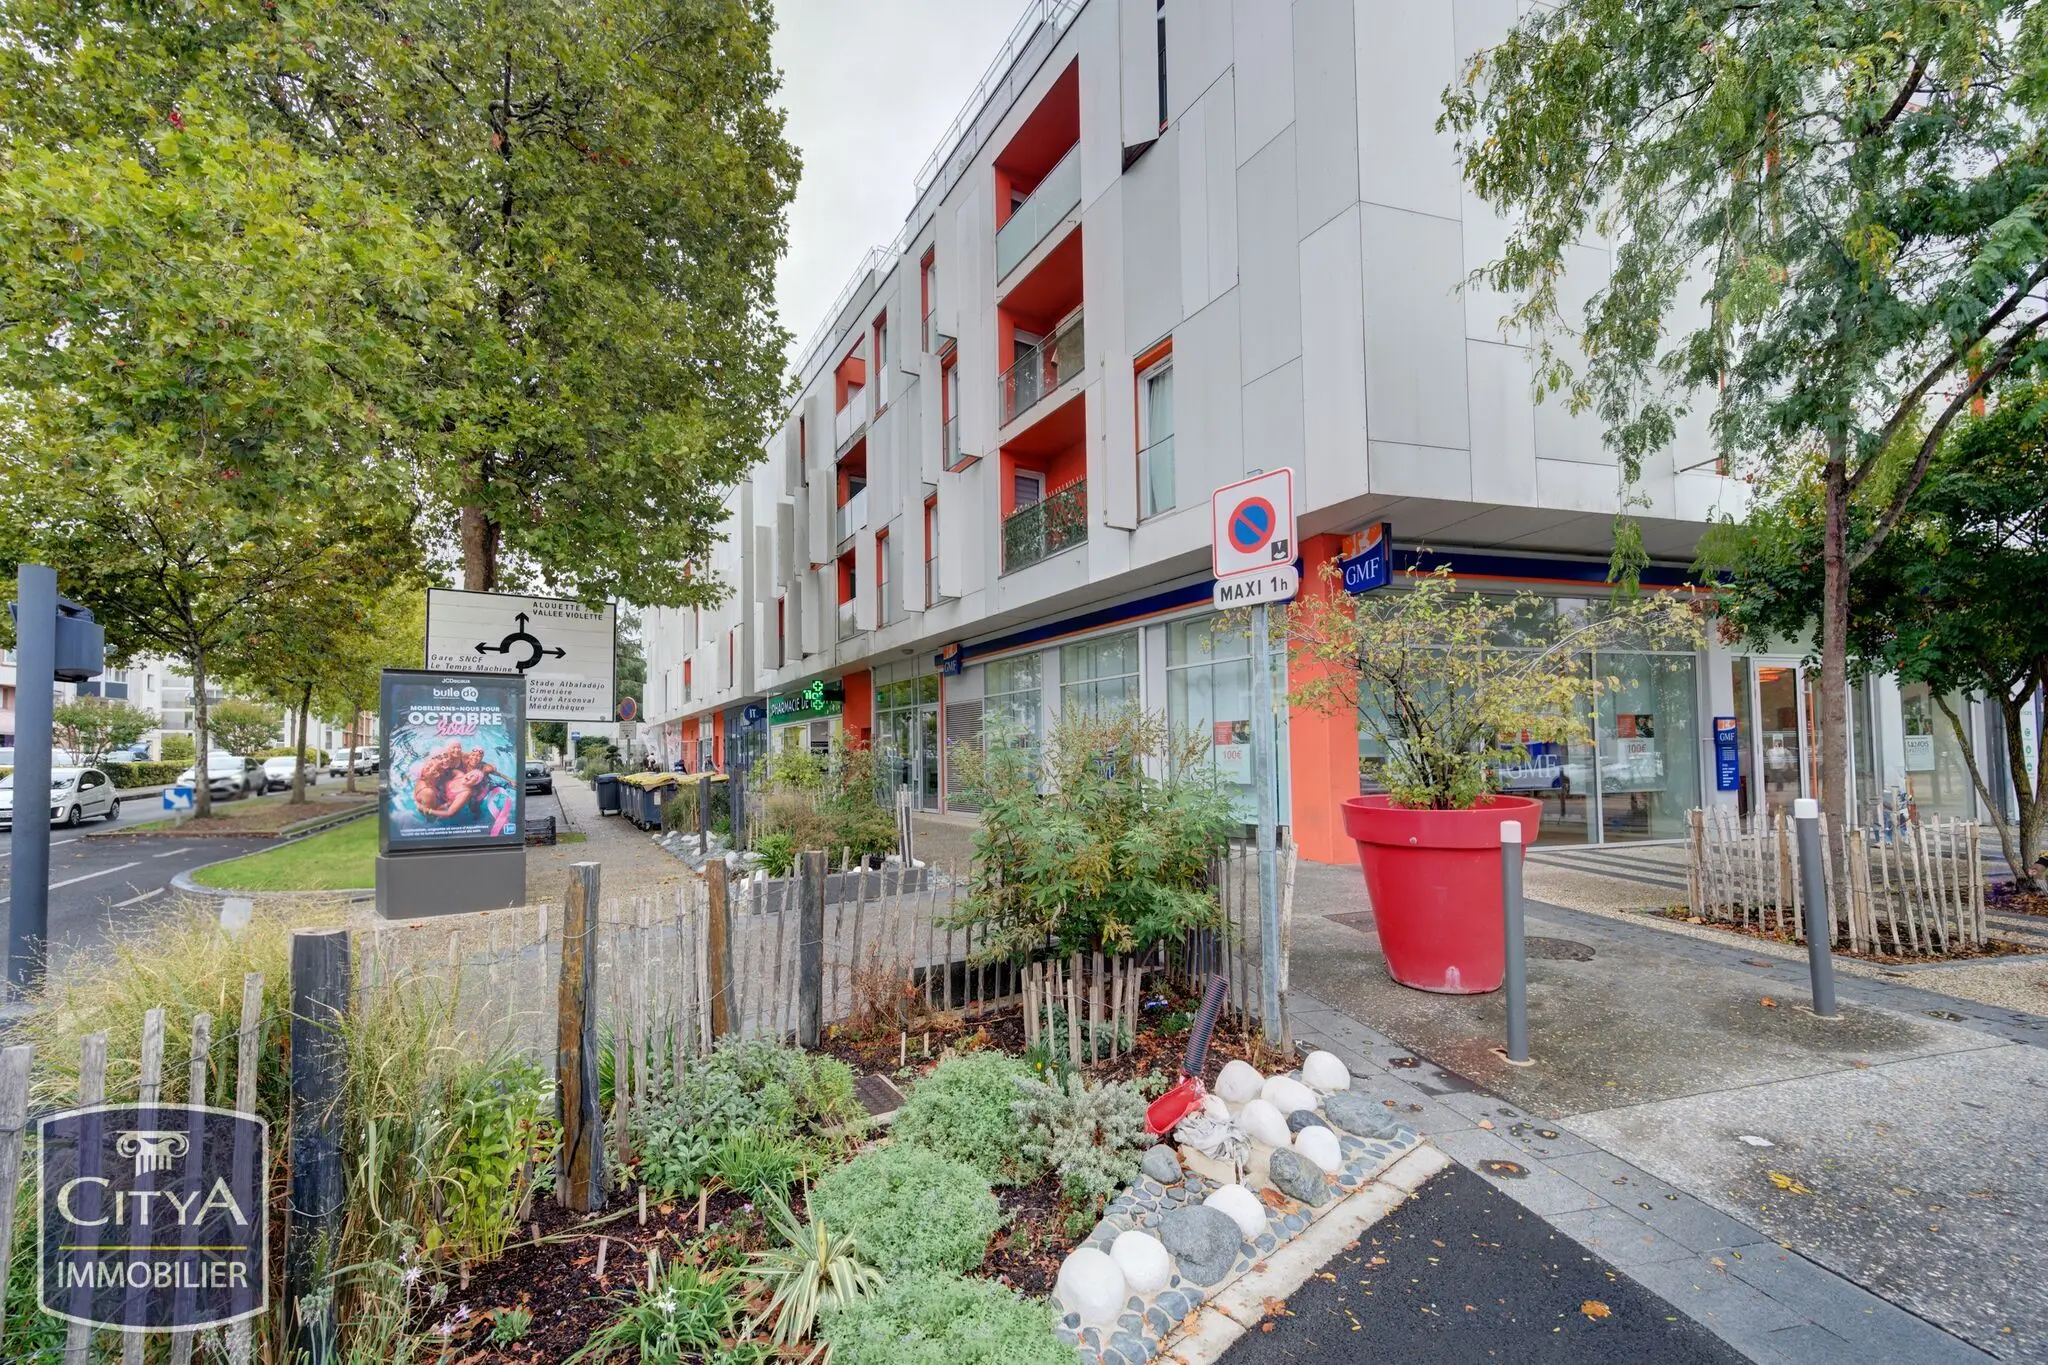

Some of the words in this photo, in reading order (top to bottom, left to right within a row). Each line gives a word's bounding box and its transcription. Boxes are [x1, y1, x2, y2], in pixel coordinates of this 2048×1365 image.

[1345, 557, 1380, 586] GMF
[1220, 580, 1262, 602] MAXI
[1270, 576, 1288, 593] 1h
[532, 601, 581, 611] ALOUETTE
[532, 609, 563, 618] VALLEE
[565, 611, 603, 621] VIOLETTE
[431, 653, 454, 661] Gare
[458, 655, 484, 663] SNCF
[445, 662, 472, 671] Temps
[475, 664, 513, 673] Machine
[432, 687, 460, 698] bulle
[529, 687, 573, 696] Cimetière
[528, 695, 553, 703] Lycée
[557, 696, 596, 704] Arsonval
[528, 702, 585, 712] Médiathèque
[771, 697, 800, 717] PHARMACIE
[407, 711, 503, 726] OCTOBRE
[1719, 732, 1735, 742] GMF
[1506, 754, 1558, 780] GMF
